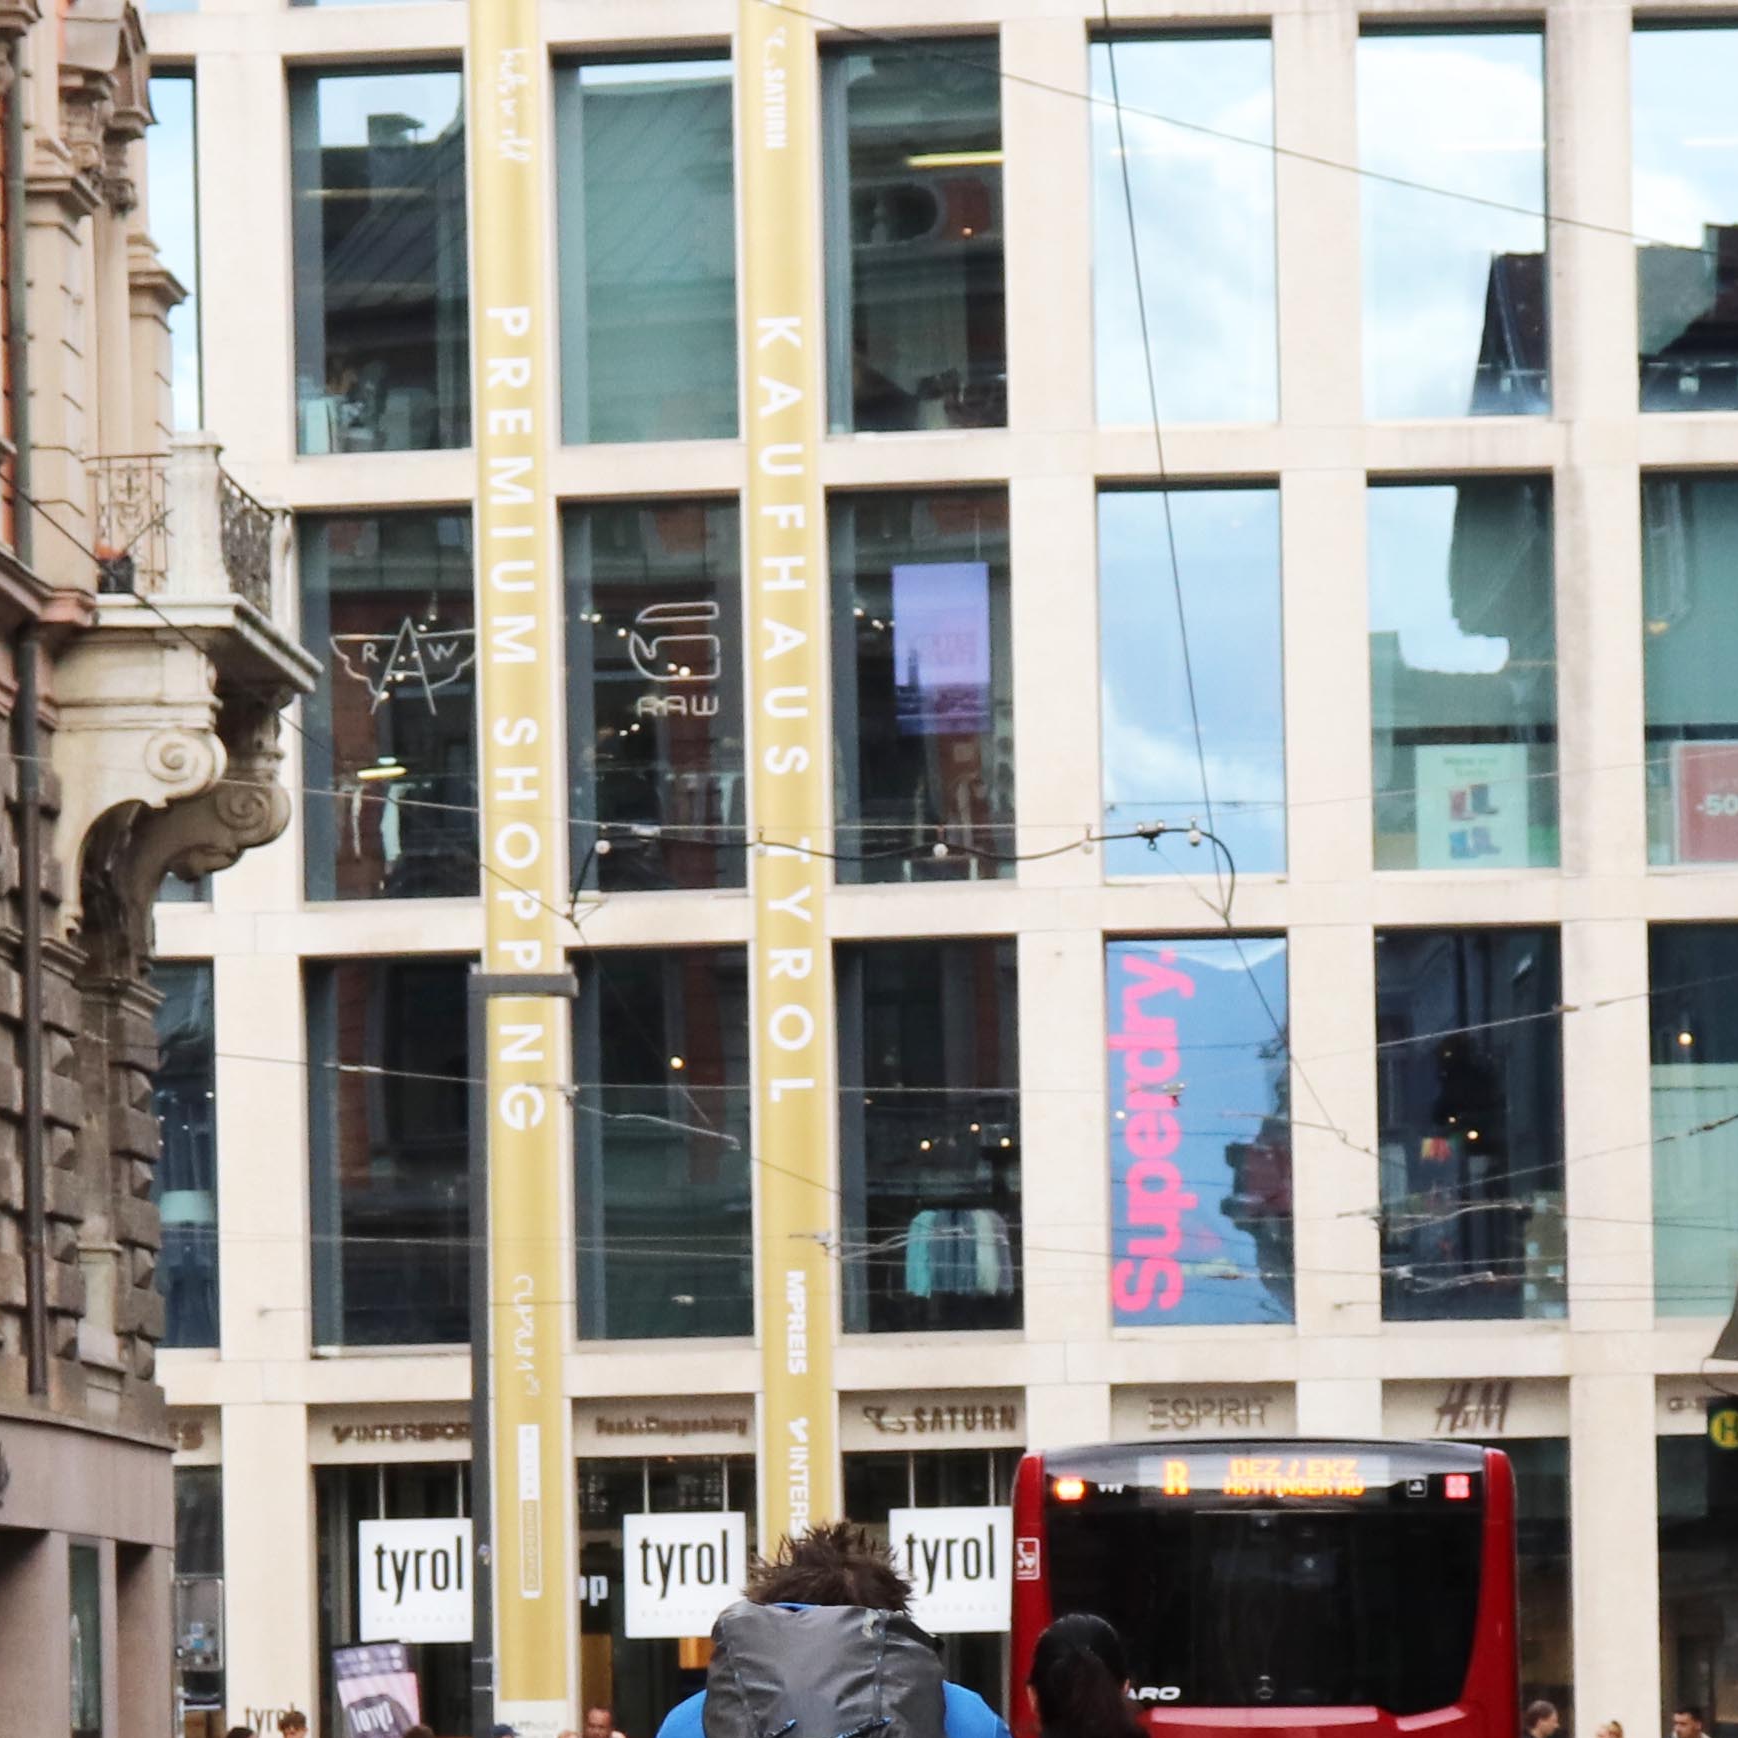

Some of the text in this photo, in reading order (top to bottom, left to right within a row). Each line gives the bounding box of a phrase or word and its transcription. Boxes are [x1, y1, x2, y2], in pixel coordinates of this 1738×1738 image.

[761, 68, 785, 149] SATURN
[487, 306, 546, 1132] PREMIUM SHOPPNG
[757, 315, 816, 1103] KAUFHAUS TYROL
[786, 1270, 808, 1376] MPREIS
[913, 1404, 1017, 1433] SATURN
[1148, 1397, 1272, 1431] ESPRIT
[1436, 1383, 1513, 1432] H&M
[1165, 1459, 1190, 1496] R
[374, 1535, 464, 1607] tyrol
[639, 1529, 731, 1600] tyrol
[905, 1522, 995, 1596] tyrol
